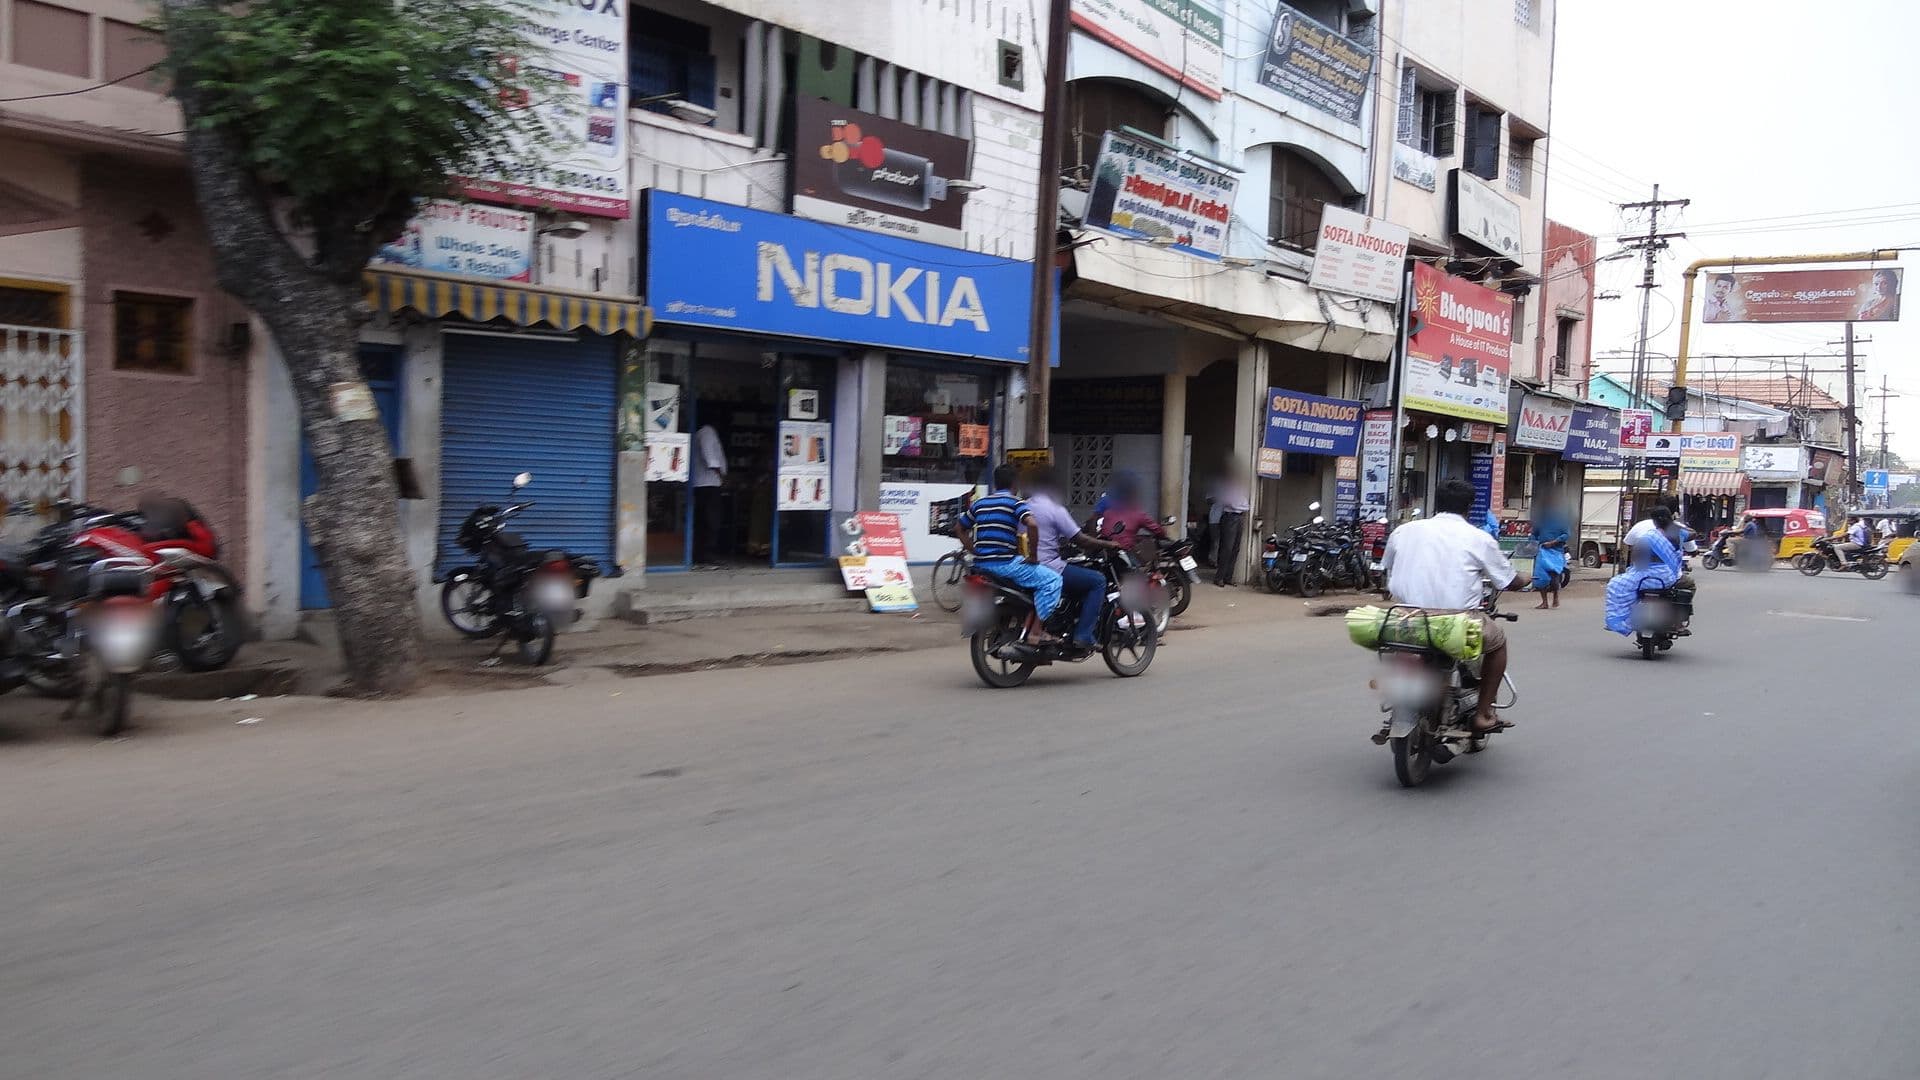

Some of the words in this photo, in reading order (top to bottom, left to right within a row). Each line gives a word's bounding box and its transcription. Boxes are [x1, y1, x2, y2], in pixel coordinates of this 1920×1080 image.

[1193, 12, 1220, 40] India
[574, 29, 621, 52] Center
[434, 236, 486, 255] Whole
[487, 243, 522, 260] Sale
[1323, 225, 1354, 246] SOFIA
[1355, 233, 1406, 258] INFOLOGY
[757, 241, 991, 332] NOKIA
[1745, 289, 1781, 302] ஜோஸ்
[1793, 287, 1857, 301] ஆலுக்காஸ்
[1440, 291, 1510, 337] Bhagwan's
[1450, 333, 1456, 344] A
[1455, 335, 1473, 349] House
[1473, 339, 1481, 350] of
[1486, 342, 1509, 358] Products
[1272, 395, 1310, 417] SOFIA
[1311, 402, 1361, 421] INFOLOGY
[1520, 407, 1570, 433] NAAZ
[1288, 434, 1296, 445] PC
[1583, 438, 1608, 450] NAAZ
[1707, 436, 1735, 449] மலர்
